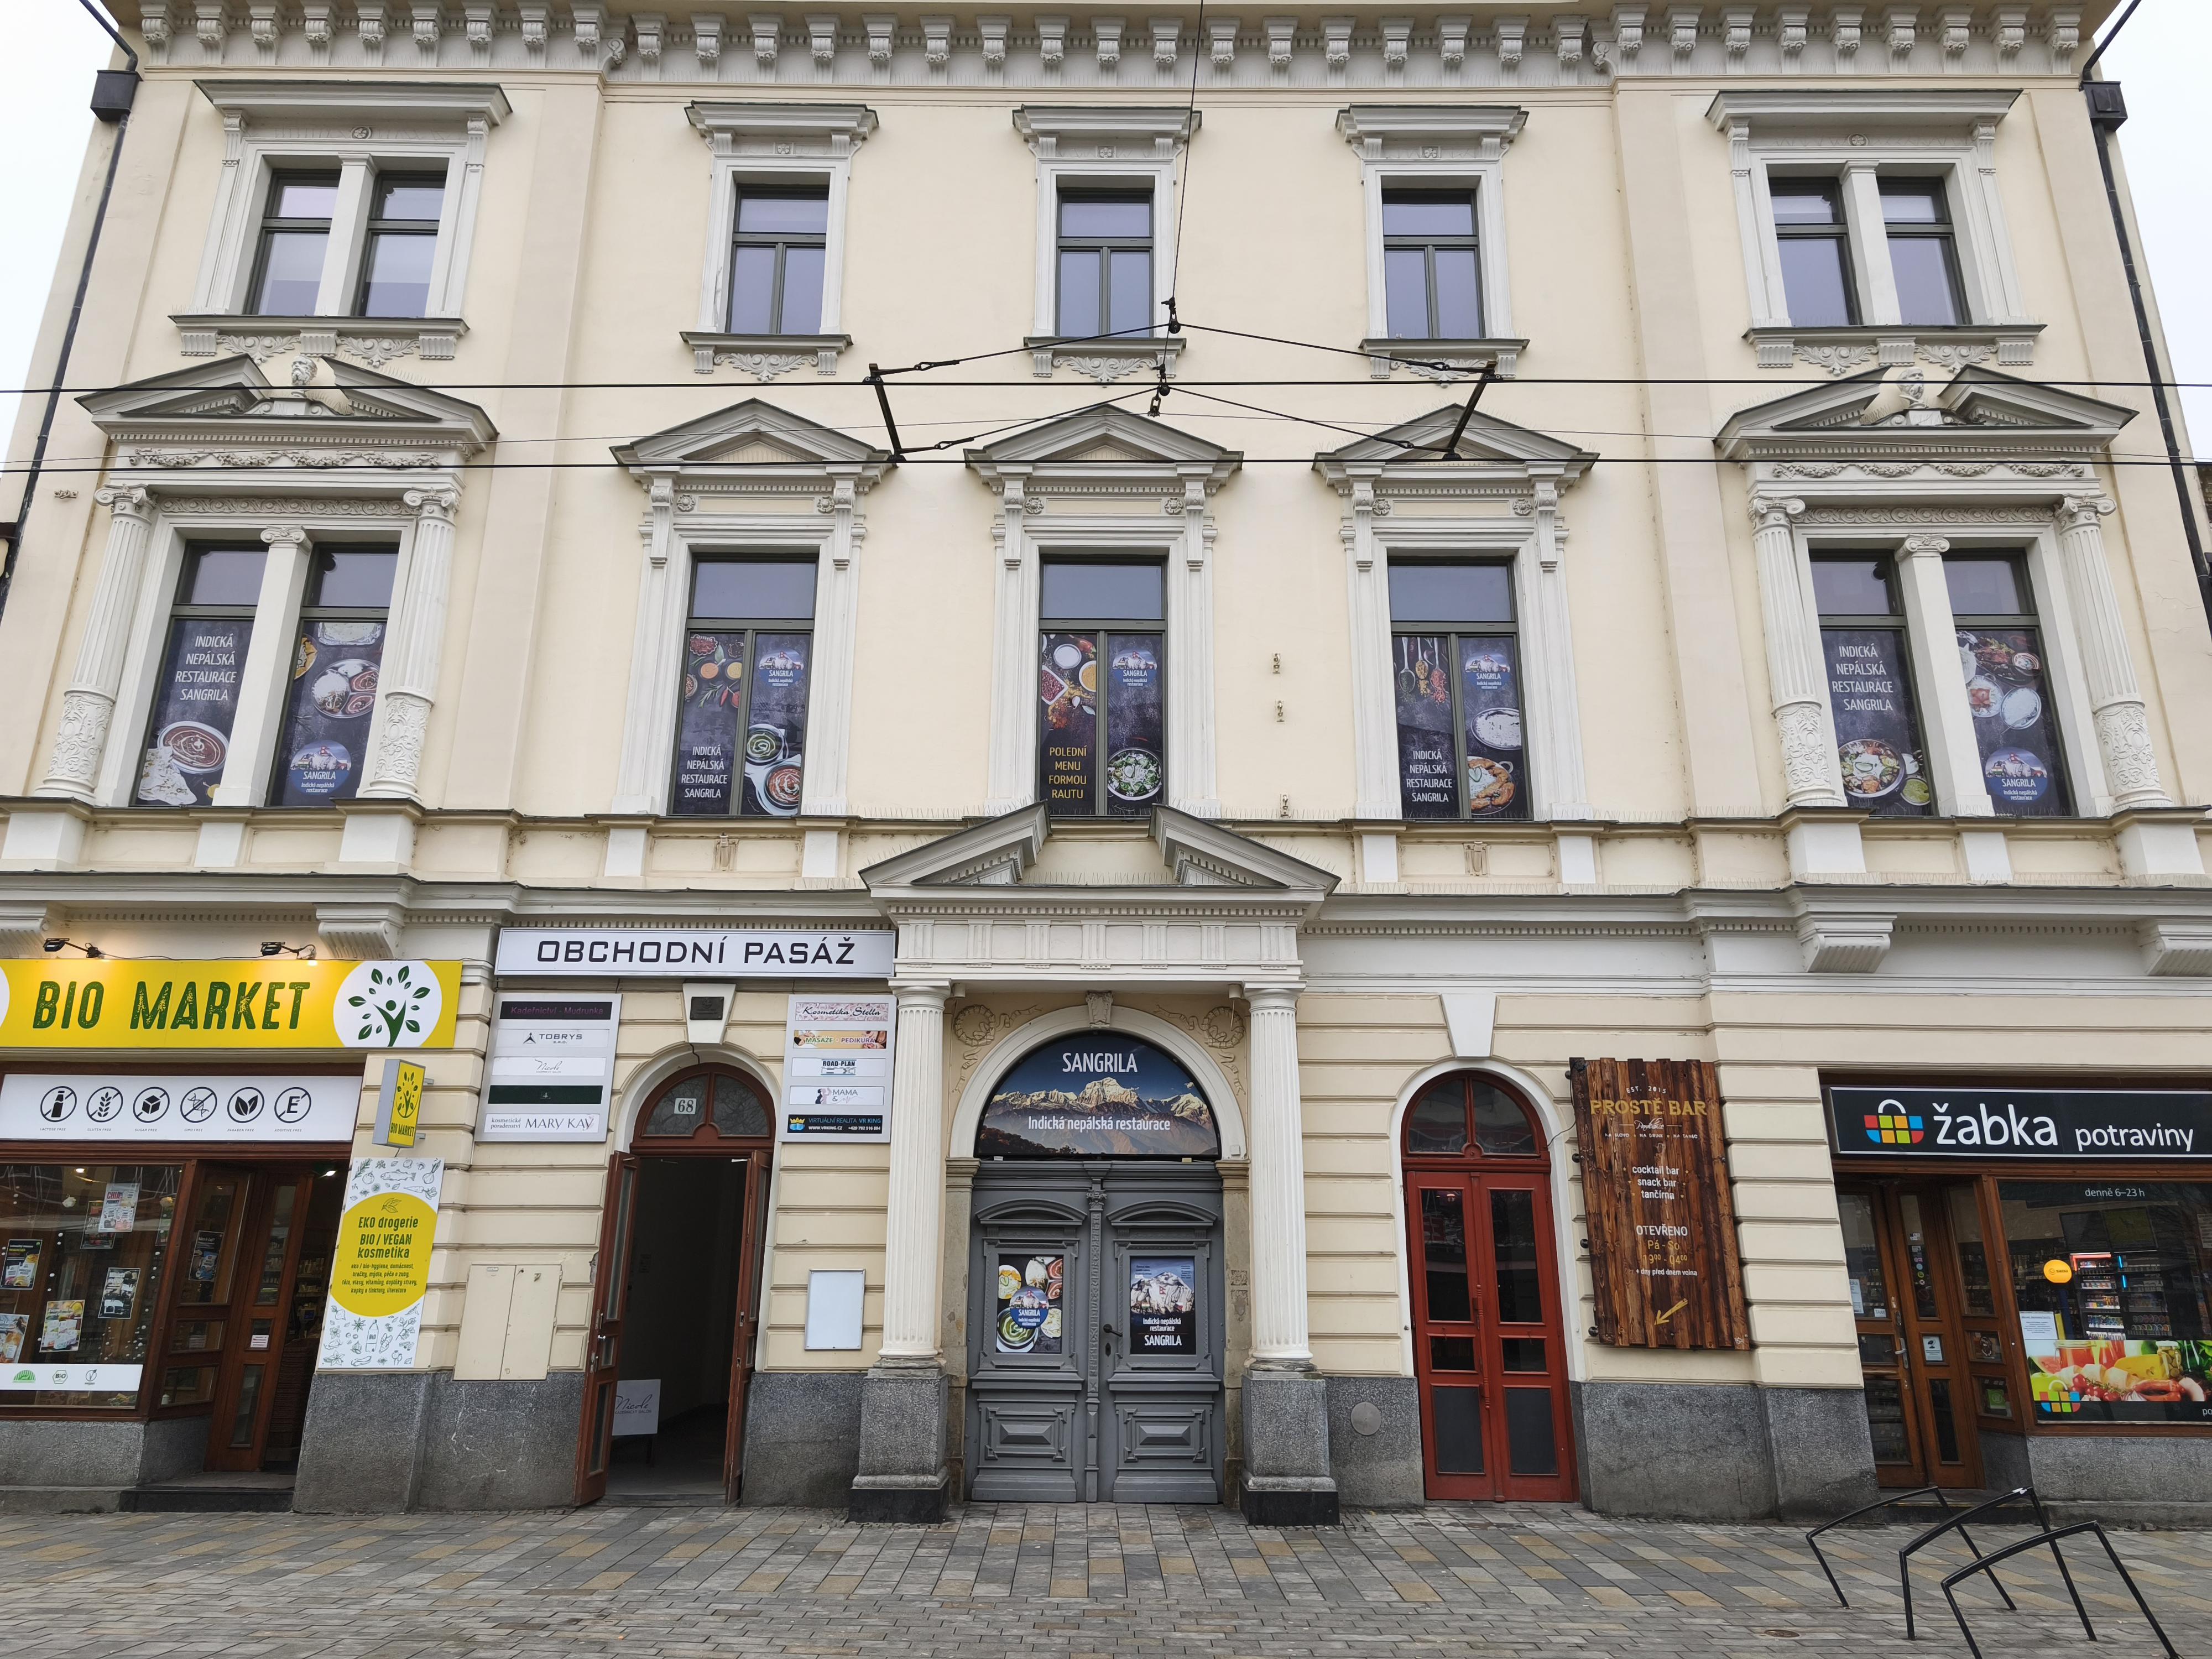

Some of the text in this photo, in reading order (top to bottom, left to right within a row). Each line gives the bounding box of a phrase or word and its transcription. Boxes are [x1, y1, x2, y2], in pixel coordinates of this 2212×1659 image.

[195, 633, 233, 647] INDICKÁ
[1839, 643, 1878, 658] INDICKÁ
[186, 651, 235, 665] NEPÁLSKÁ
[1836, 661, 1886, 675] NEPÁLSKÁ
[175, 671, 236, 683] RESTAURACE
[1832, 681, 1893, 693] RESTAURACE
[180, 688, 228, 701] SANGRILA
[1843, 699, 1893, 711] SANGRILA
[692, 744, 721, 756] INDICKÁ
[1050, 745, 1087, 757] POLEDNÍ
[1413, 748, 1442, 760] INDICKÁ
[687, 758, 724, 770] NEPÁLSKÁ
[1055, 761, 1081, 770] MENU
[1410, 763, 1447, 774] NEPÁLSKÁ
[302, 771, 336, 780] SANGRILA
[681, 774, 728, 784] RESTAURACE
[1049, 775, 1087, 785] FORMOU
[1406, 778, 1452, 788] RESTAURACE
[2002, 778, 2036, 787] SANGRILA
[685, 789, 721, 798] SANGRILA
[1052, 789, 1083, 799] RAUTU
[1412, 792, 1449, 802] SANGRILA
[537, 936, 855, 964] OBCHODNÍ PASÁŽ
[32, 981, 310, 1030] BIO MARKET
[511, 1006, 557, 1015] Kadeřnictví
[802, 1006, 881, 1016] Kosmetika Stella
[1062, 1052, 1138, 1072] SANGRILA
[1648, 1086, 1667, 1094] 2015
[677, 1099, 693, 1113] 68
[1590, 1098, 1707, 1115] PROSTĚ BAR
[398, 1124, 415, 1137] MARKET
[525, 1118, 594, 1131] MARY KAY
[1029, 1116, 1170, 1133] Indická nepálská restaurace
[1932, 1103, 2193, 1152] žabka potraviny
[1632, 1165, 1679, 1175] cocktail bar
[1637, 1178, 1677, 1187] snack bar
[1641, 1190, 1674, 1199] tančírna
[2085, 1188, 2114, 1197] denně
[2138, 1188, 2145, 1197] h
[358, 1216, 419, 1231] EKO drogerie
[1636, 1223, 1688, 1237] OTEVŘENO
[360, 1234, 375, 1245] BIO
[384, 1234, 412, 1245] VEGAN
[1647, 1239, 1679, 1250] Pá So
[357, 1246, 410, 1258] kosmetika
[1144, 1335, 1182, 1346] SANGRILA
[615, 1394, 653, 1410] Nicole
